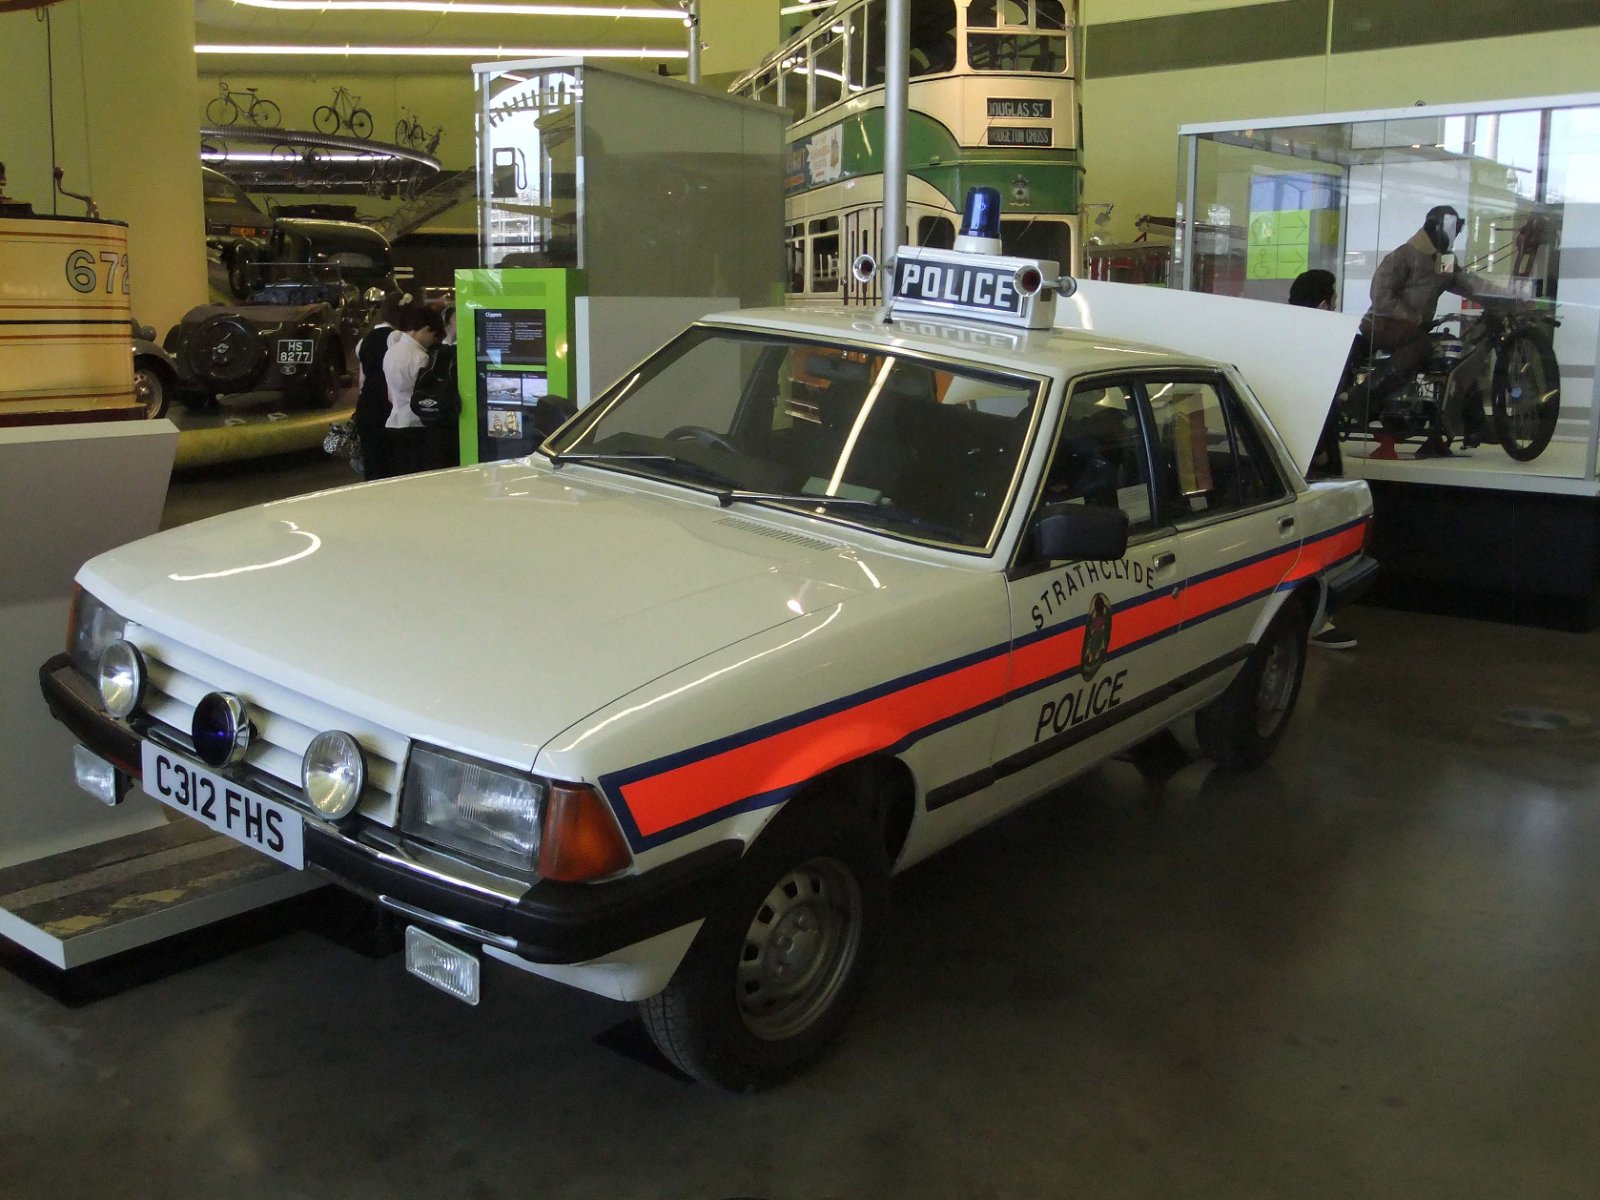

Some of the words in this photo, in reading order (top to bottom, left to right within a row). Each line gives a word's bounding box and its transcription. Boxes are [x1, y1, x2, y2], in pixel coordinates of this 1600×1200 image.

[901, 263, 1013, 308] POLICE
[280, 351, 310, 362] 8277
[288, 341, 303, 352] HS
[1031, 559, 1154, 631] STRATHCLYDE
[1034, 669, 1128, 743] POLICE
[156, 754, 217, 821] C312
[225, 788, 284, 853] FHS
